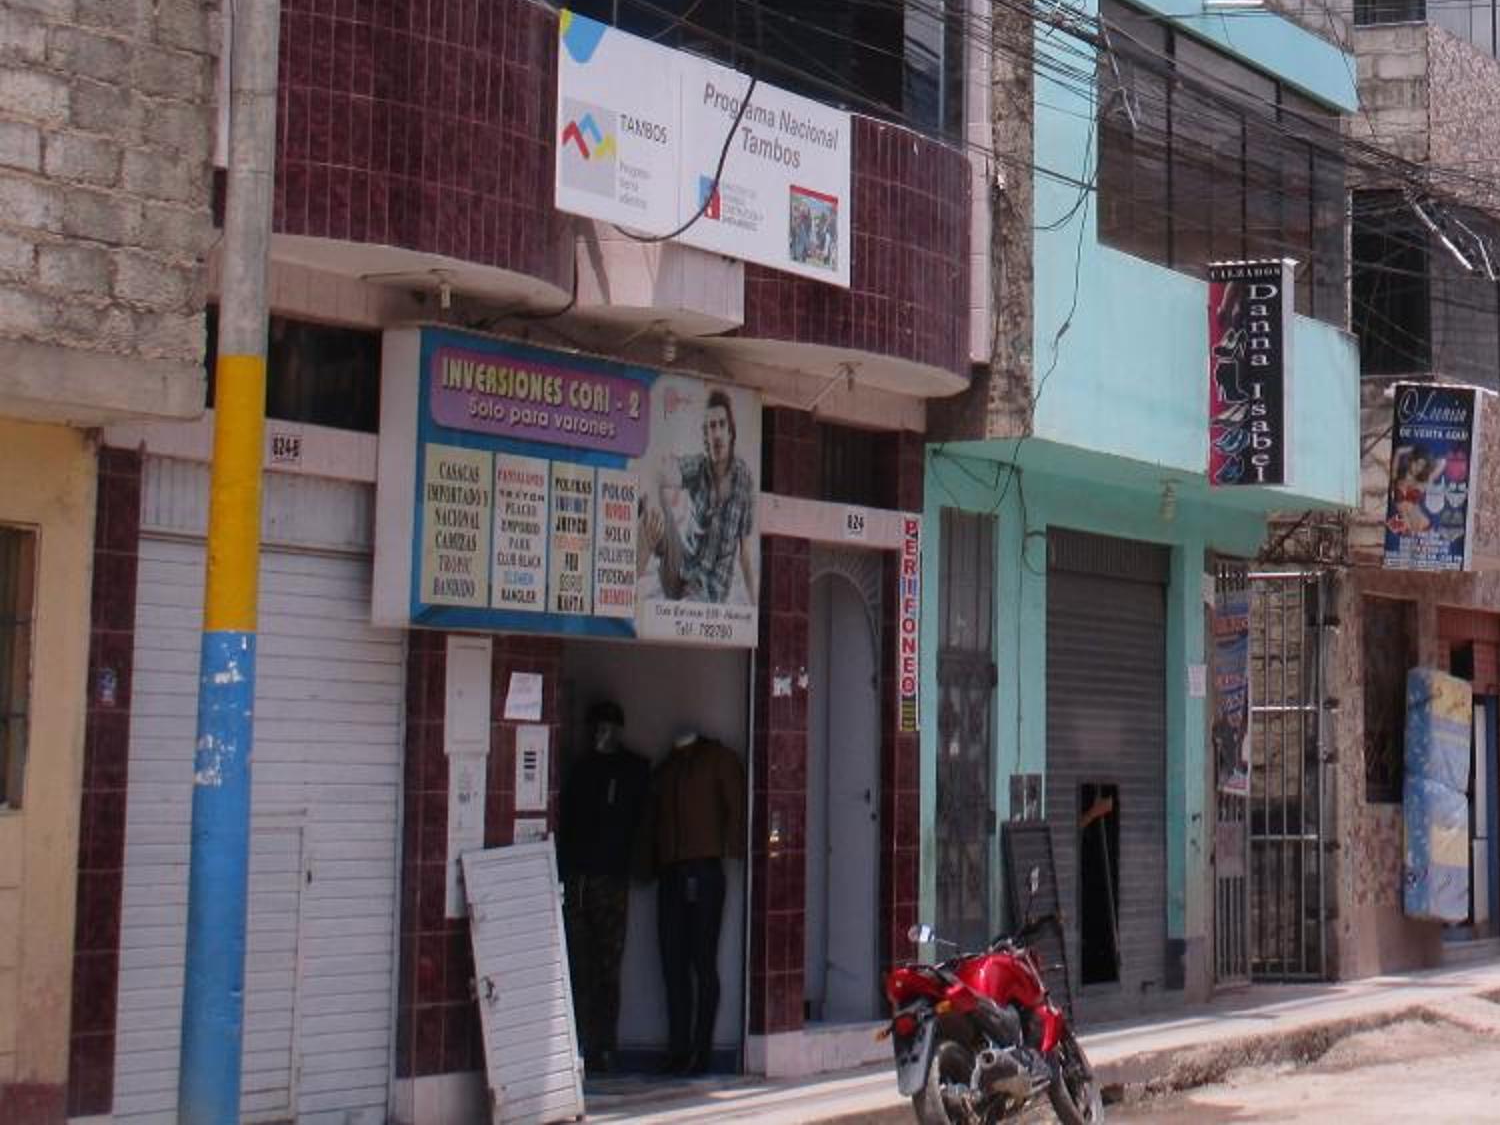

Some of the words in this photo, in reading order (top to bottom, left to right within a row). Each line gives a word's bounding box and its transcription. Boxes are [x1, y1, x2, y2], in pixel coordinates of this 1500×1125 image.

[619, 113, 668, 145] TAMBOS
[703, 82, 776, 127] Programa
[780, 108, 839, 150] Nacional
[742, 126, 802, 169] Tambos
[1249, 284, 1279, 366] Danna
[442, 356, 563, 405] INVERSIONES
[568, 379, 611, 413] CORI
[628, 394, 640, 420] 2
[467, 396, 506, 421] Solo
[509, 405, 549, 431] para
[554, 413, 617, 438] varones
[1250, 383, 1272, 482] Isabel
[439, 460, 480, 484] CASACAS
[602, 482, 635, 501] POLOS
[427, 483, 481, 505] IMPORTADO
[434, 508, 480, 530] NACIONAL
[902, 517, 919, 696] PERIFONEO
